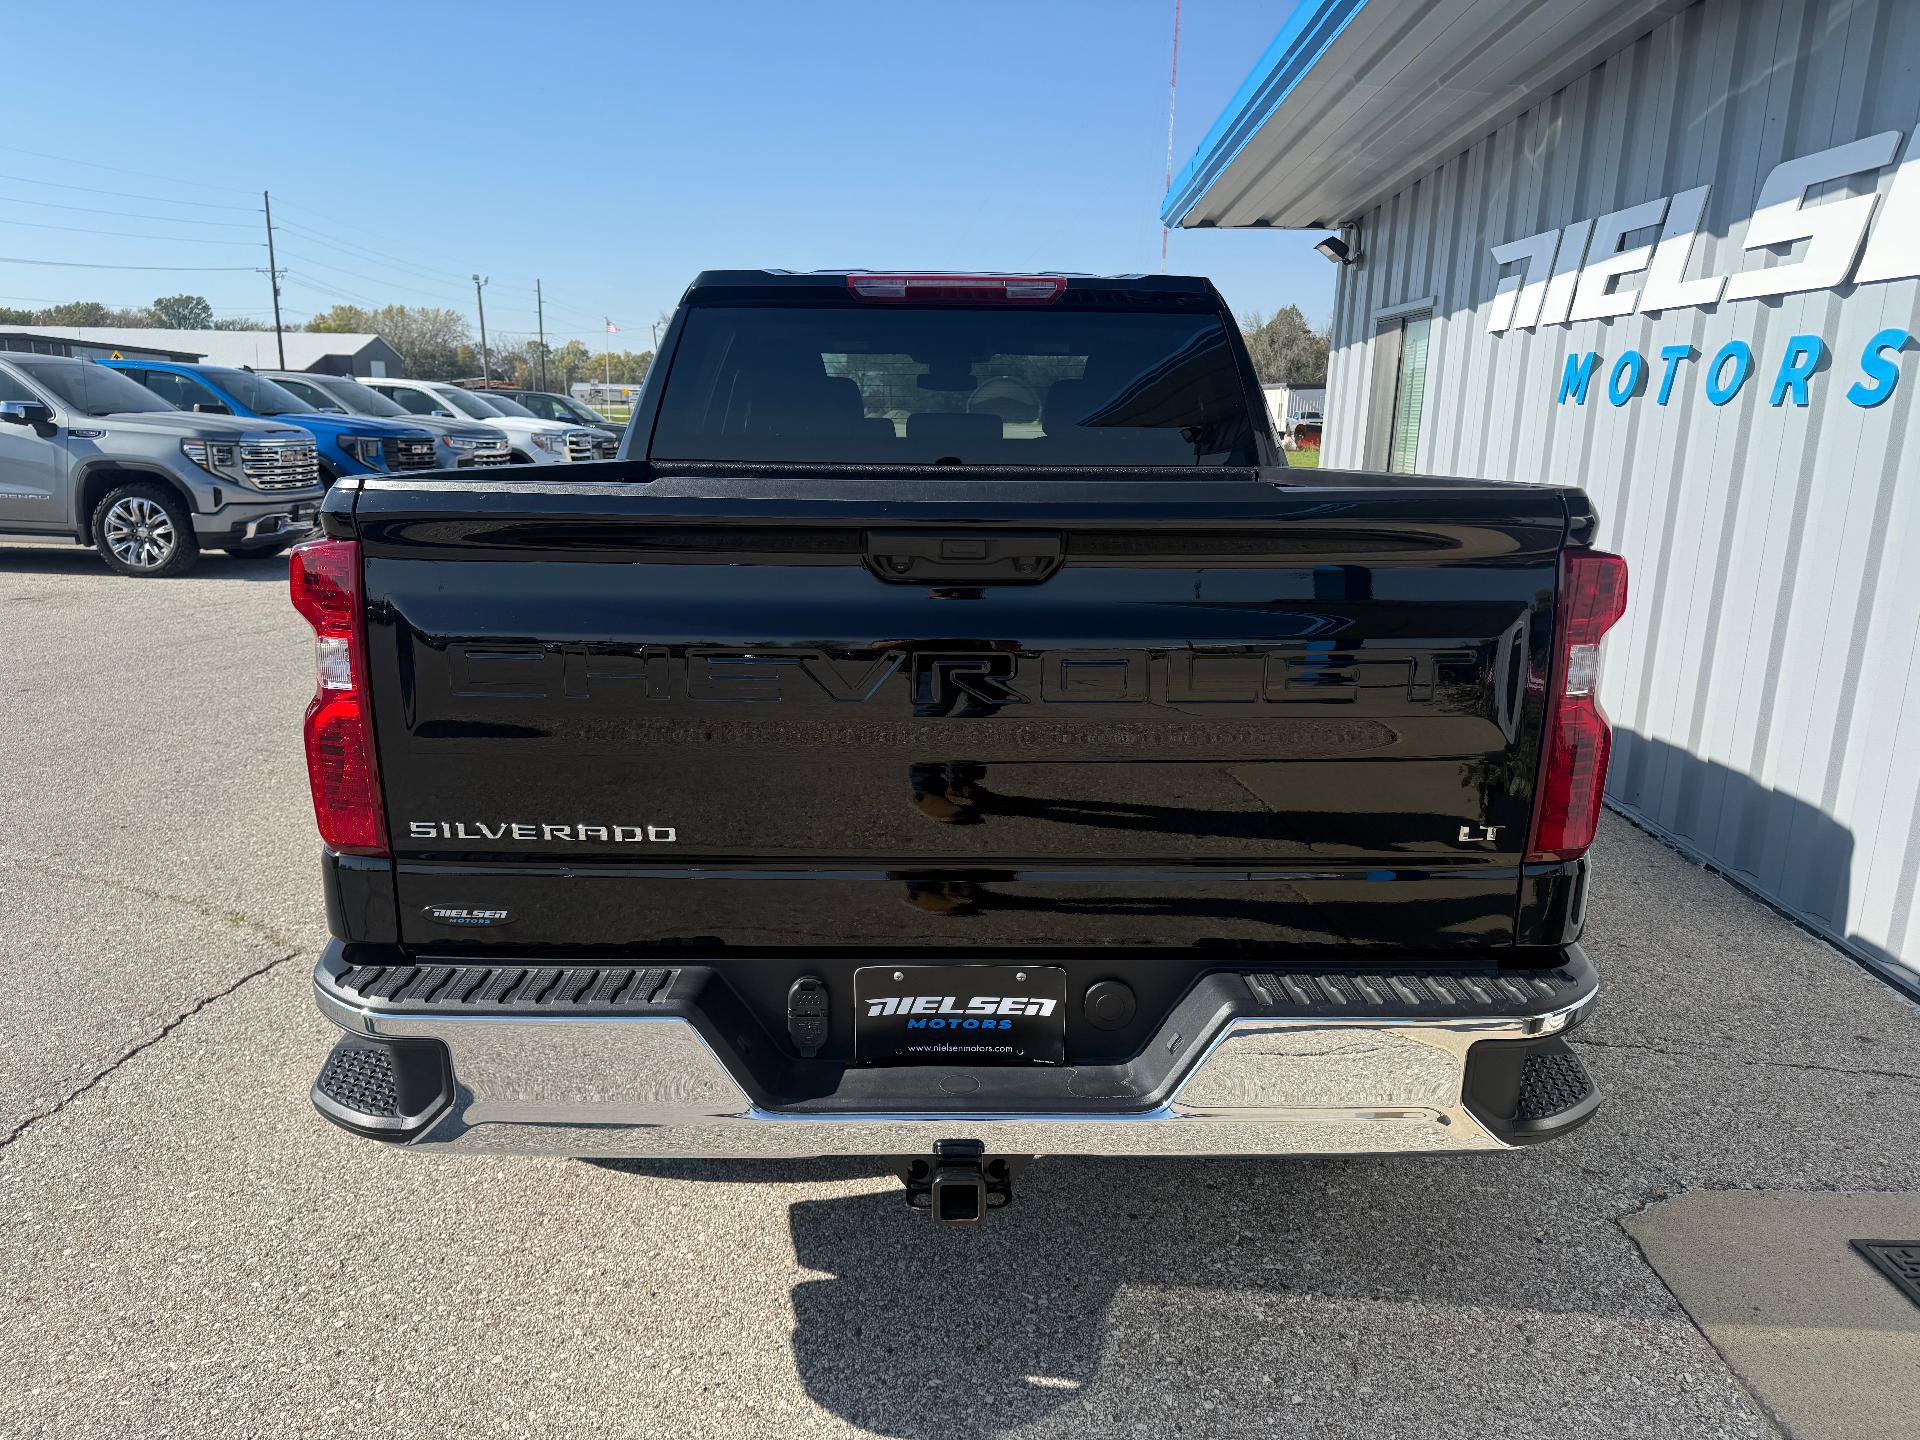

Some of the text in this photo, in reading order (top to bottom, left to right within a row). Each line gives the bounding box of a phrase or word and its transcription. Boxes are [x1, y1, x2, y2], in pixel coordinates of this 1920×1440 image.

[1488, 123, 1920, 333] NIELS
[1559, 330, 1910, 407] MOTORS
[449, 643, 1478, 704] CHEVROLET
[409, 822, 677, 842] SILVERADO
[1458, 825, 1507, 842] LT
[432, 909, 508, 919] NIELSEN
[865, 996, 1057, 1017] NIELSEN
[907, 1018, 1012, 1030] MOTORS
[907, 1043, 1013, 1054] www.nielsenmotors.com
